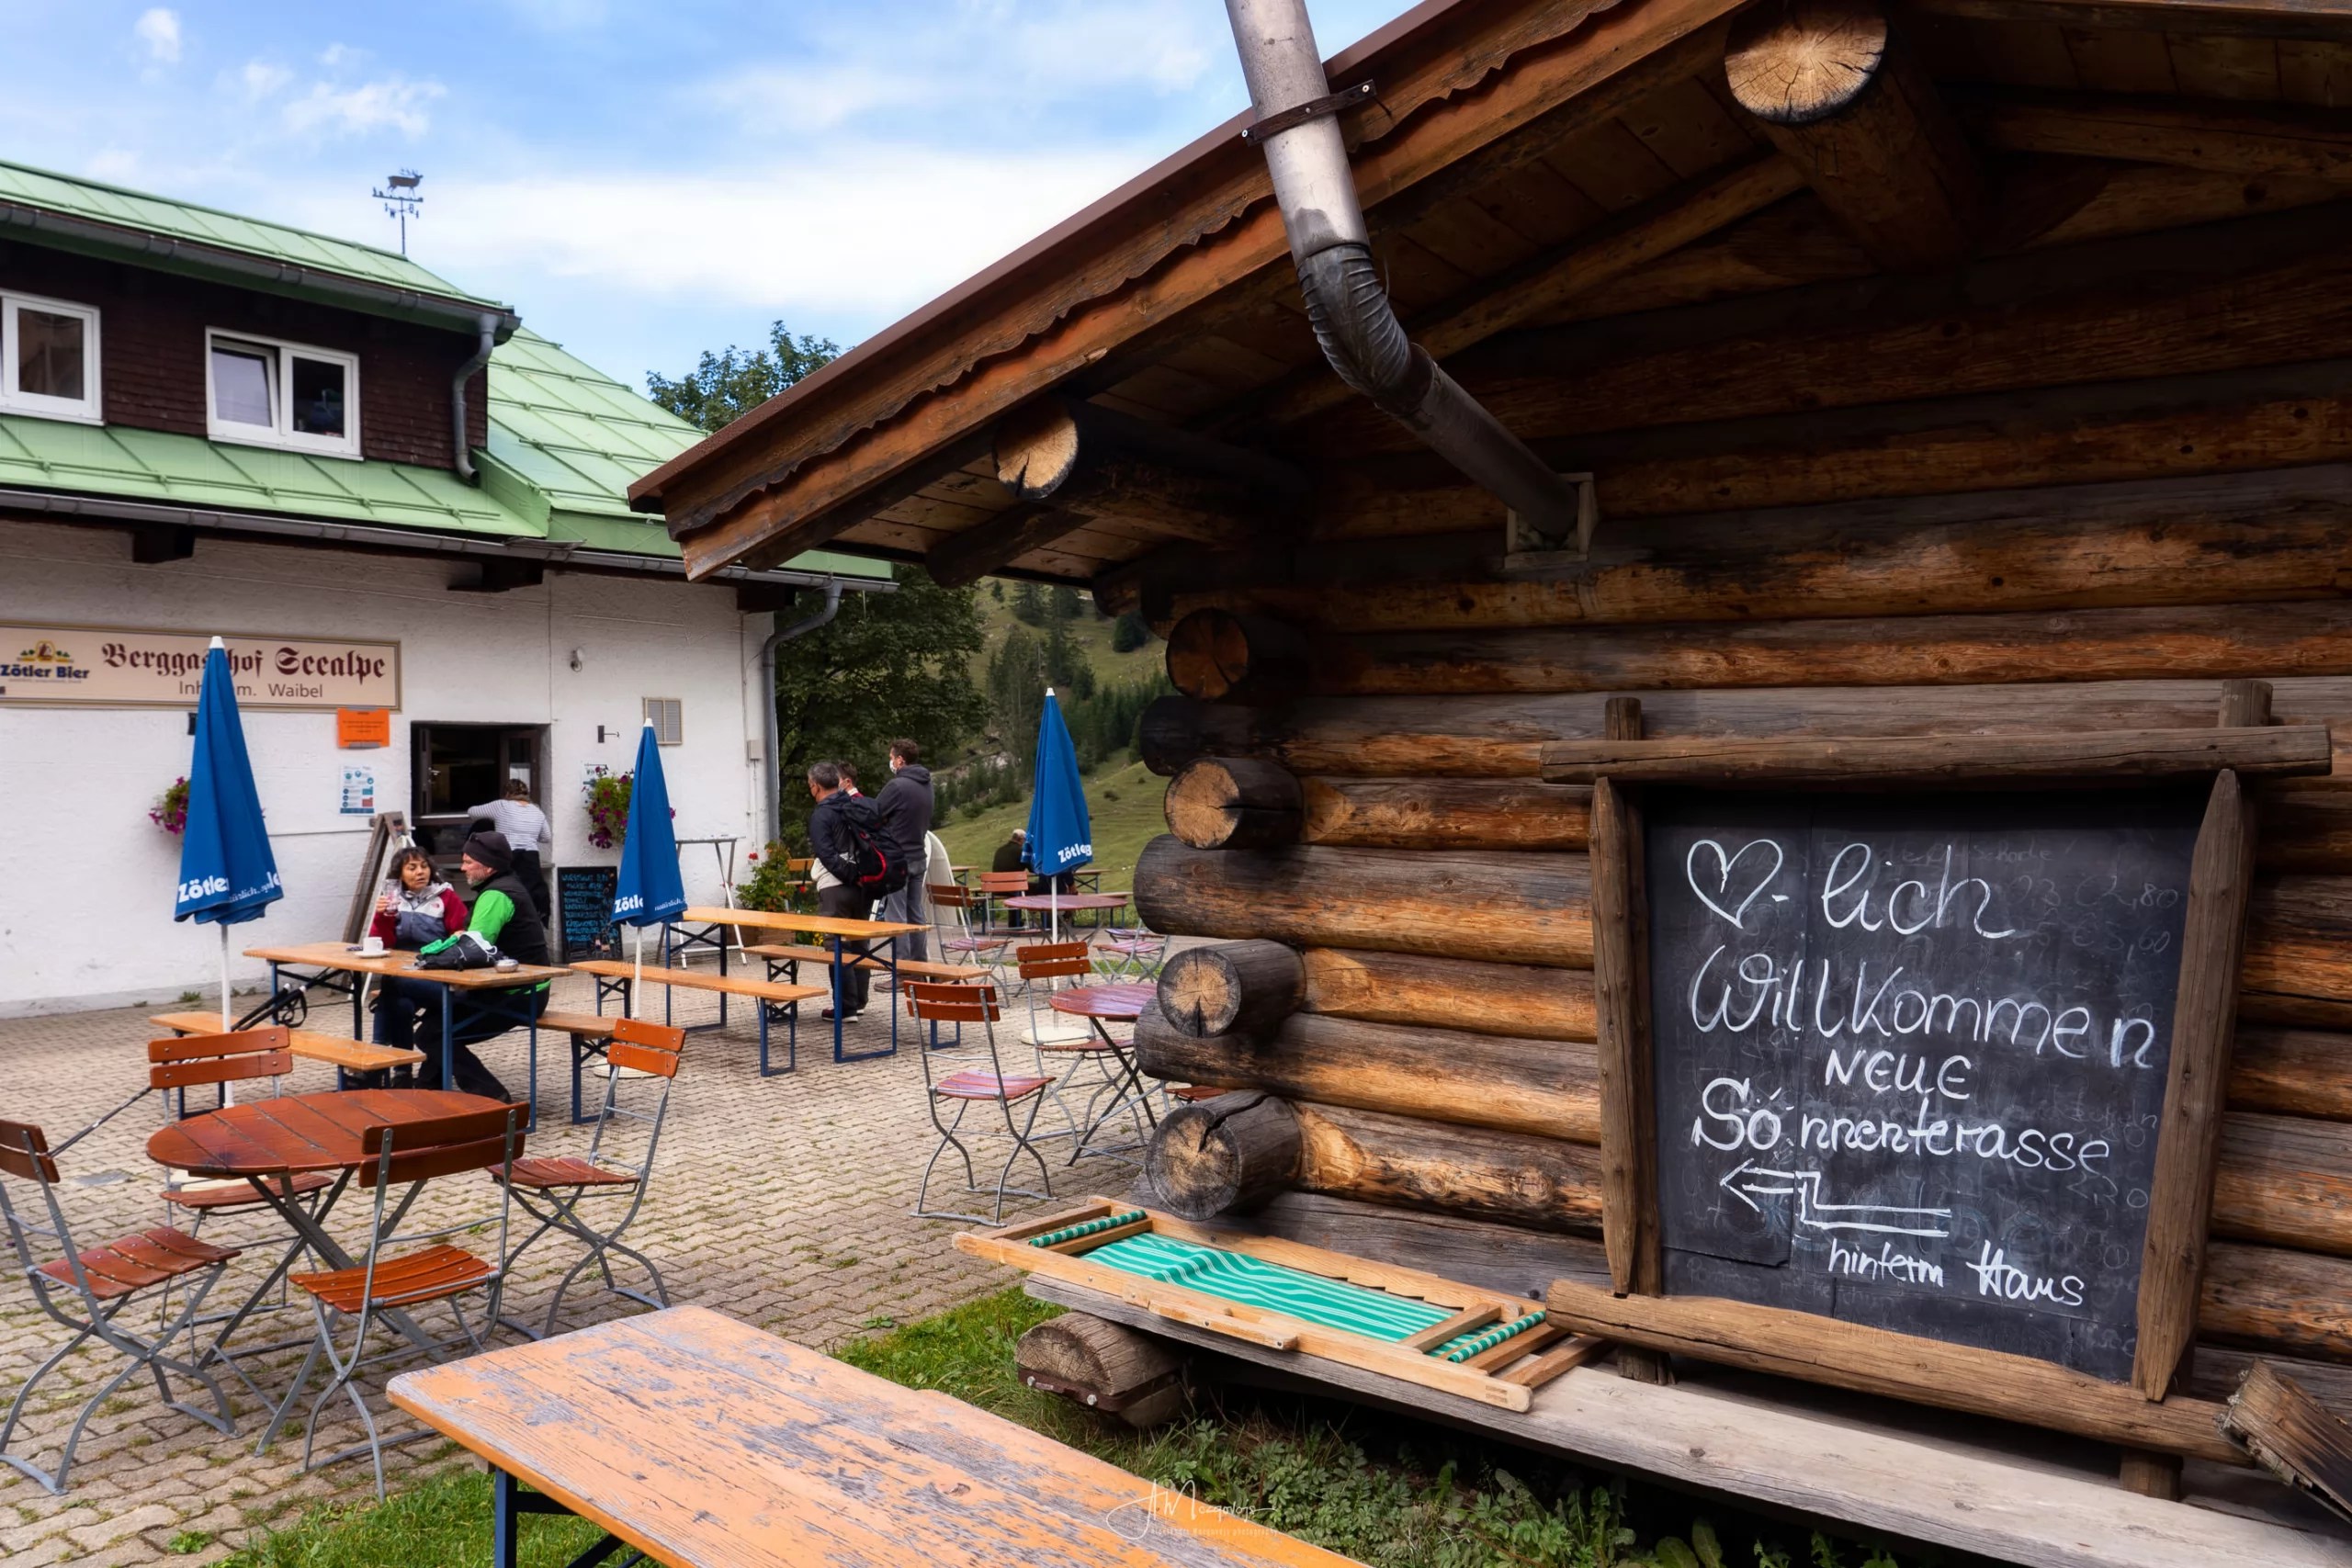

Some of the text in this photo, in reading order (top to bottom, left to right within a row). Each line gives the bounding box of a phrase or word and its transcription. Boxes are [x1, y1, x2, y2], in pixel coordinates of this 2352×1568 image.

[0, 663, 90, 679] Zötler Bier
[276, 647, 385, 685] Seealpe
[268, 683, 322, 698] Waibel
[1967, 1240, 2085, 1306] Haus
